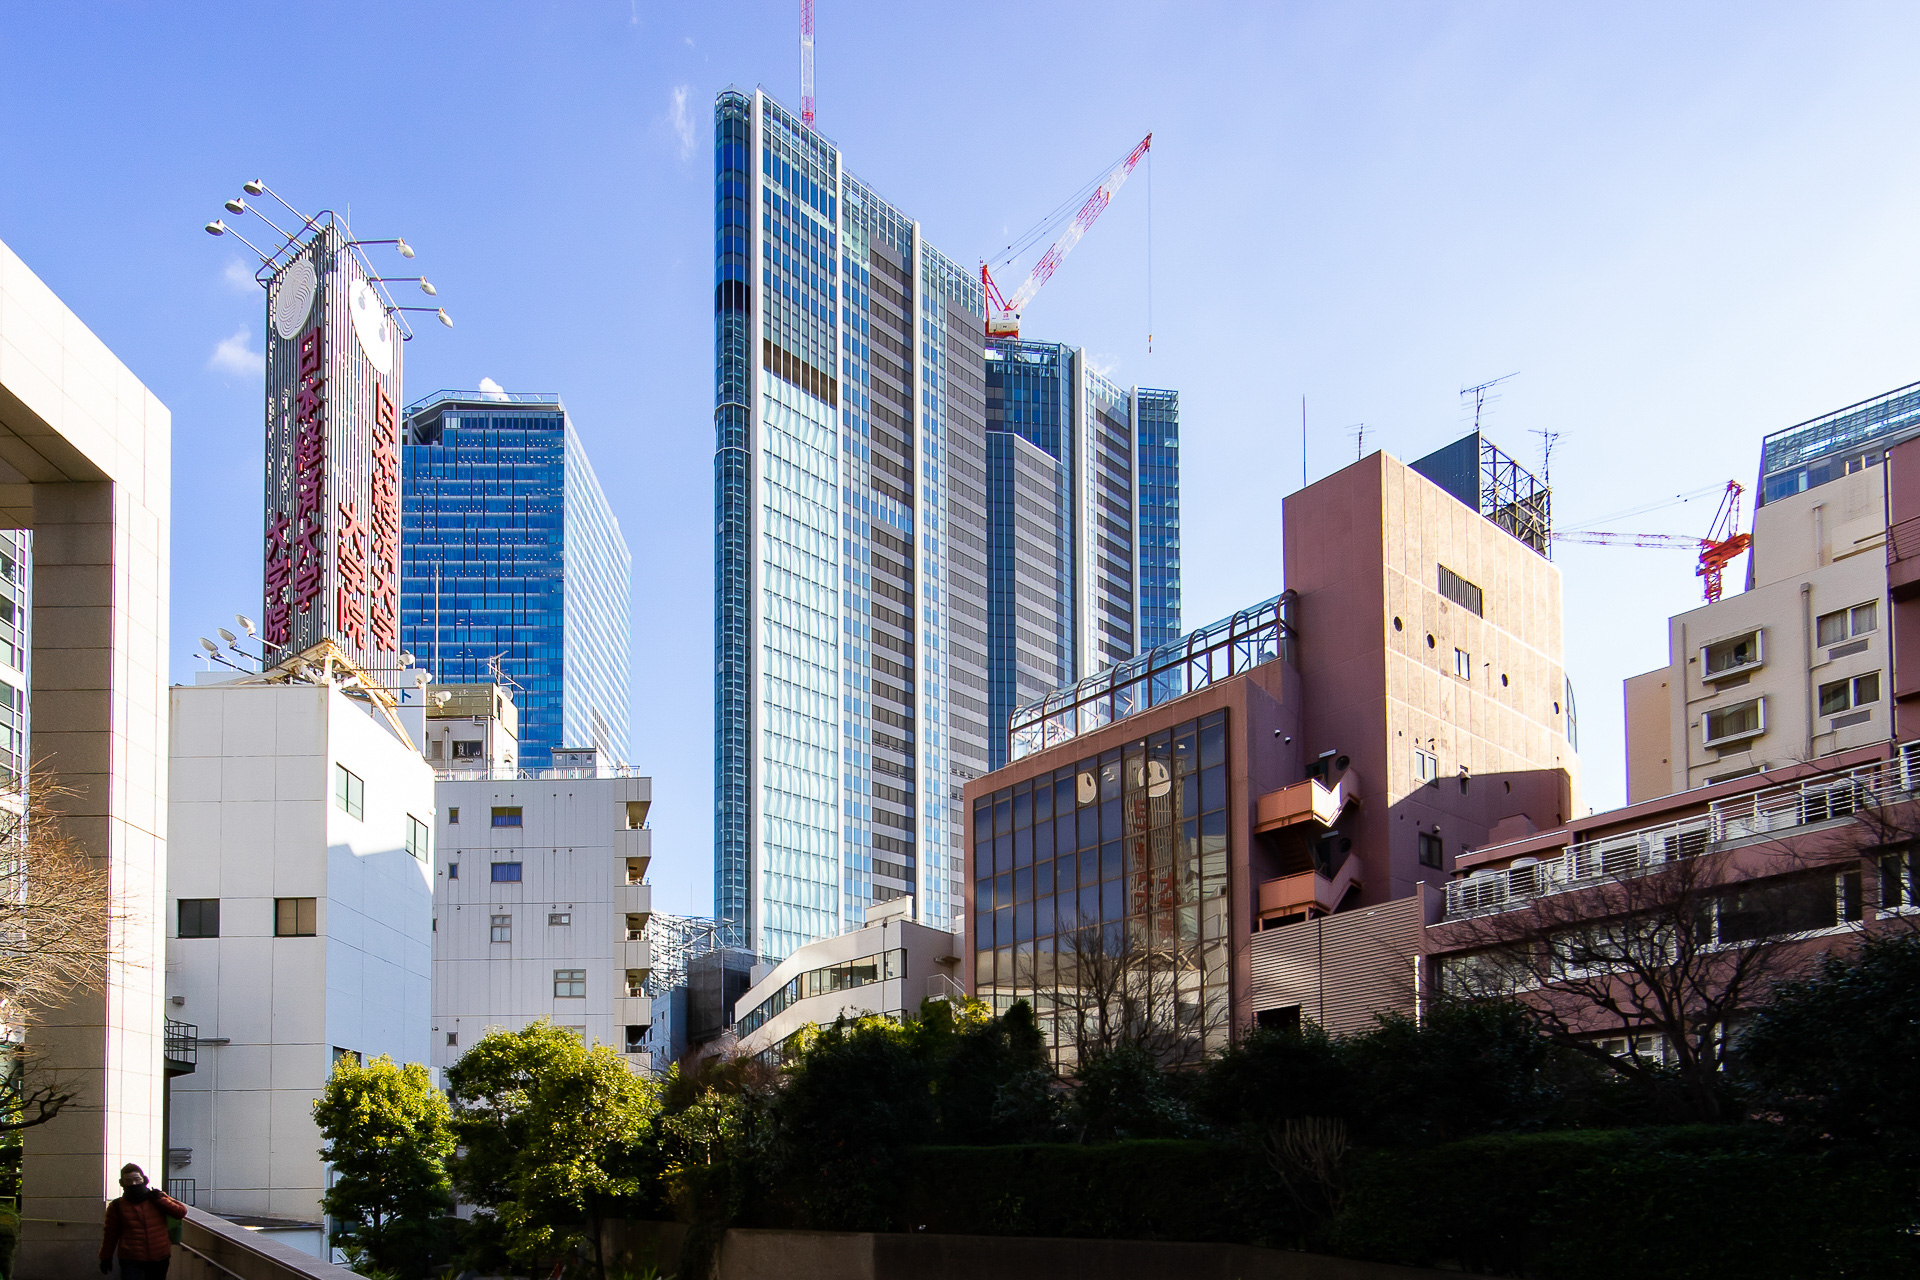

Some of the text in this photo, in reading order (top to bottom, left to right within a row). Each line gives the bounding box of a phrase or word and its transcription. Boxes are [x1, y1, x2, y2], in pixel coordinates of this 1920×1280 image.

[294, 327, 322, 613] 日本経済大学
[372, 382, 398, 651] 日本経済大学
[265, 512, 290, 653] 大学院
[338, 502, 366, 650] 大学院
